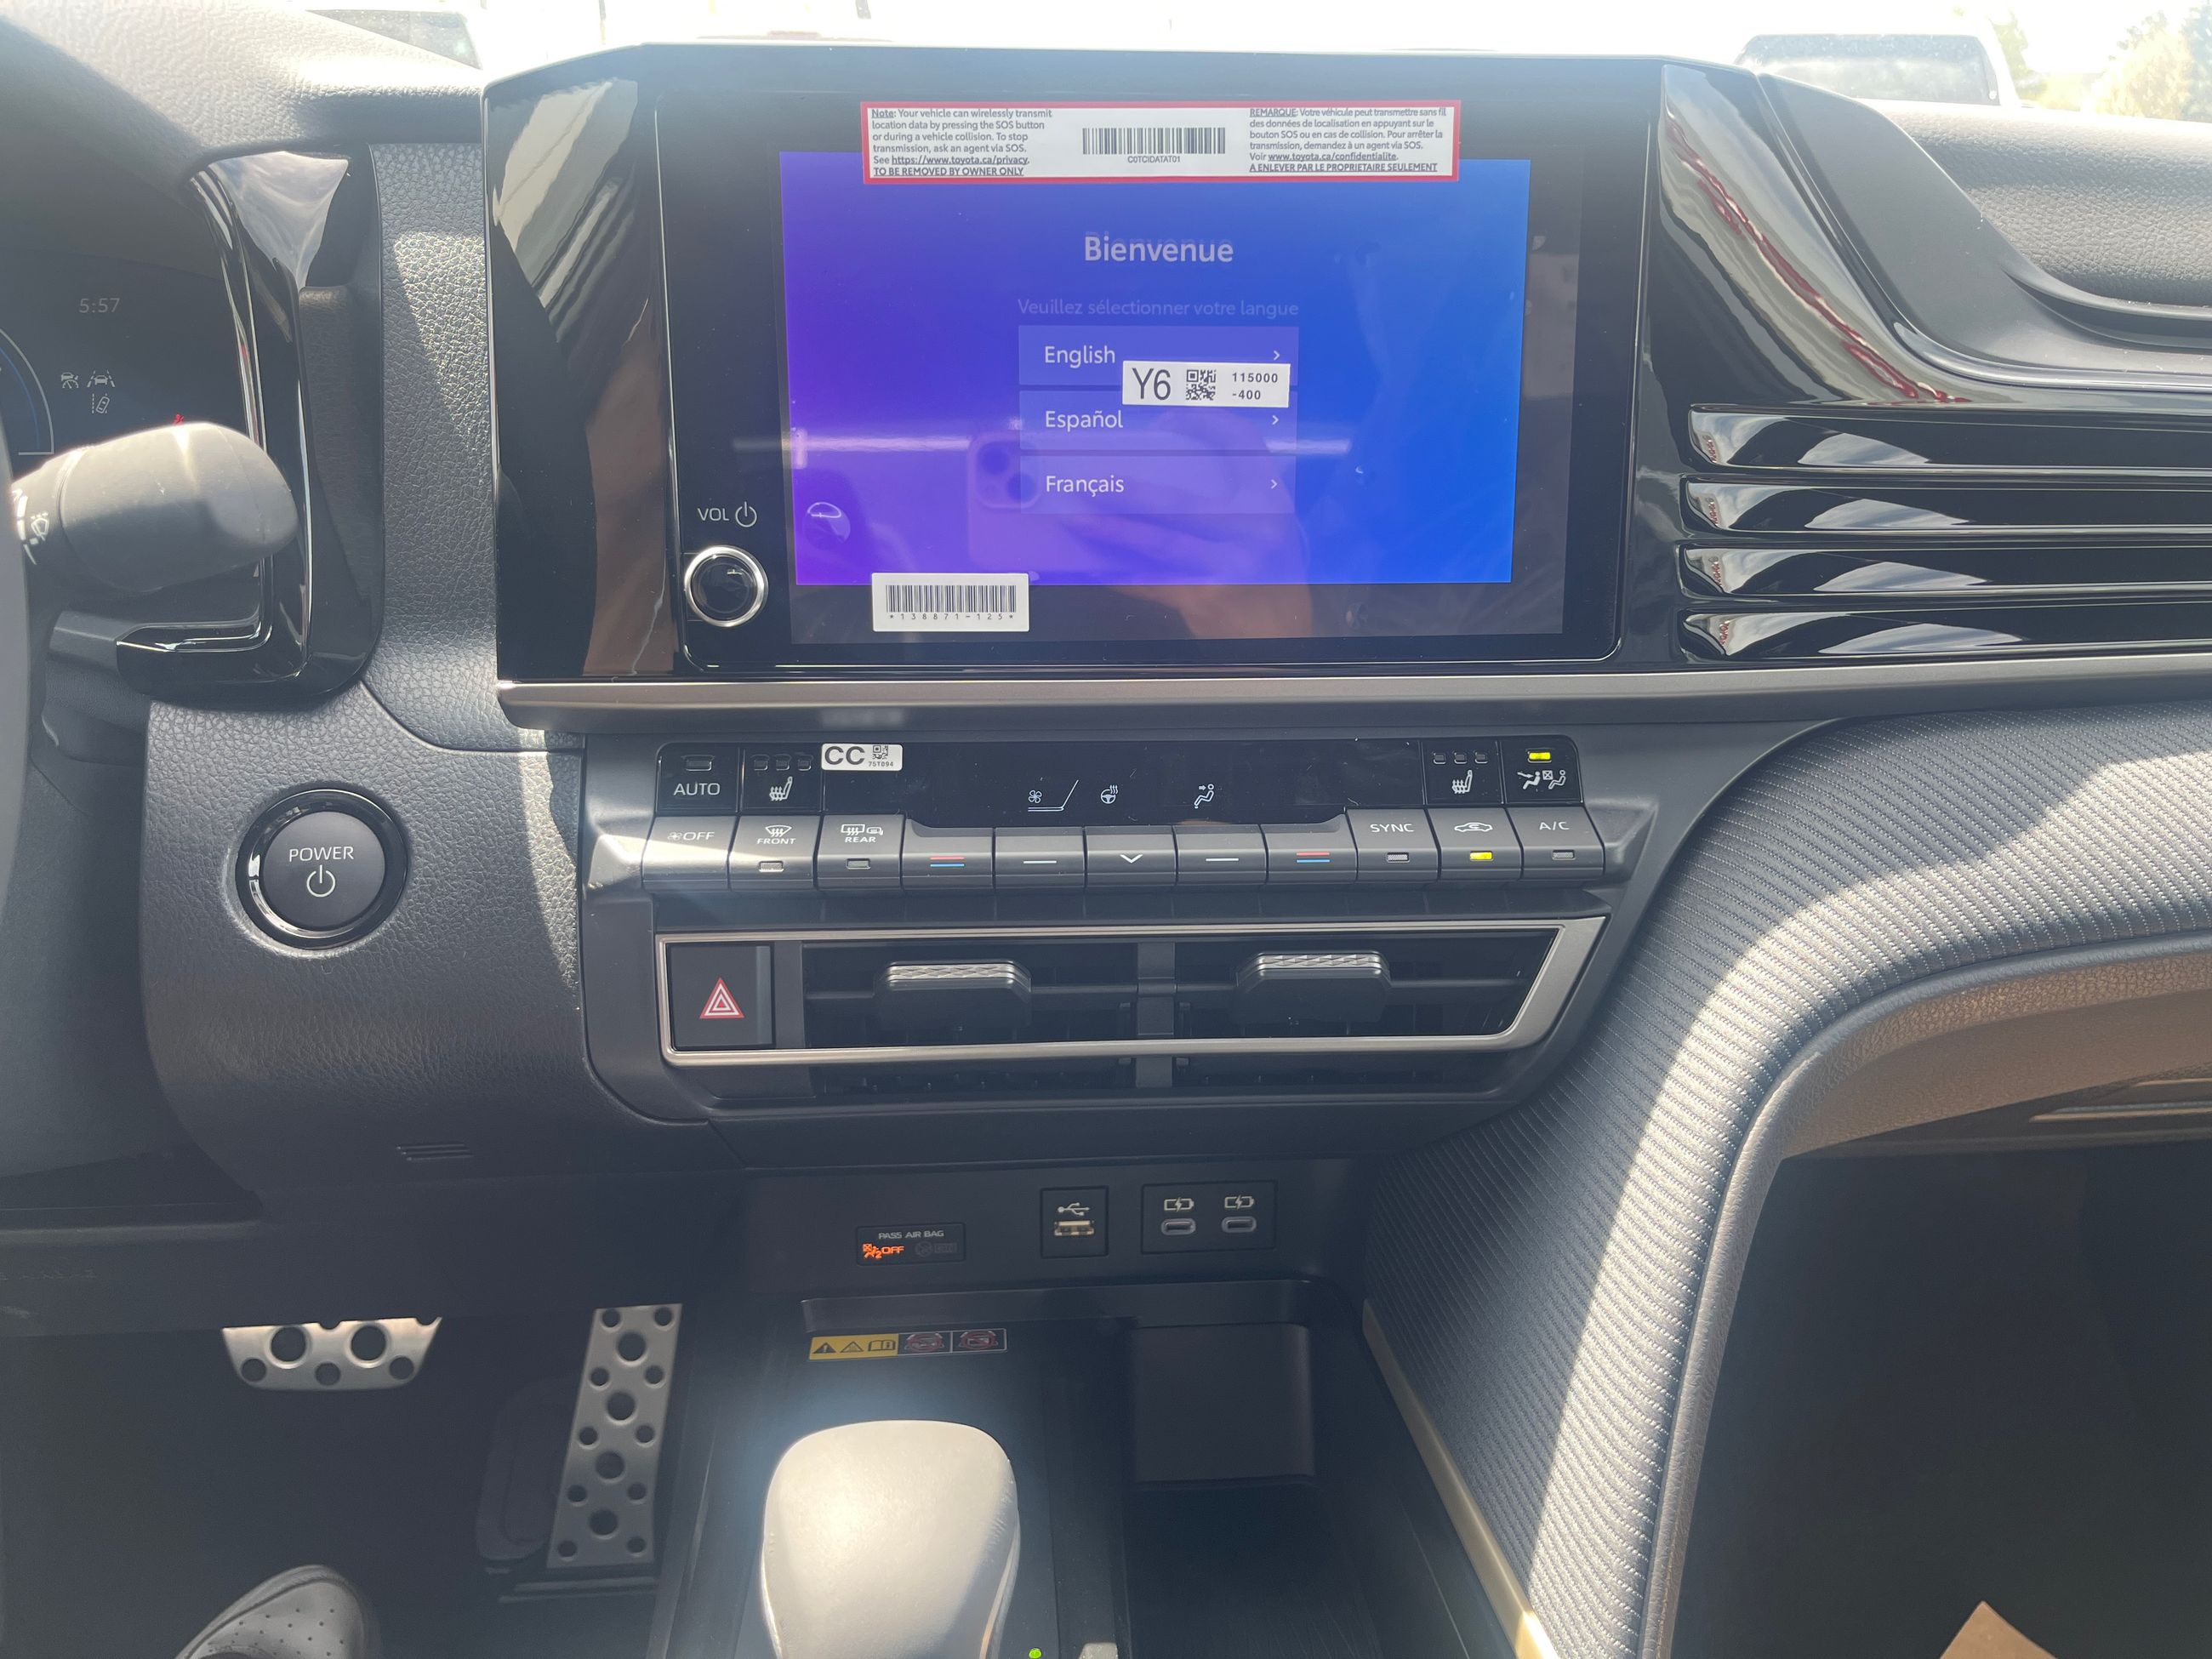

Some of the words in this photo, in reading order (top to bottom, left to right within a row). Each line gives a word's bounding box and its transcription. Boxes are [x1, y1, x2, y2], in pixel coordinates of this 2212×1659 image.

[871, 109, 896, 119] Note:
[898, 109, 918, 117] Your
[920, 109, 951, 117] vehicle
[971, 109, 1013, 119] wirelessly
[1016, 109, 1052, 117] transmit
[1250, 108, 1298, 117] REMARQUE:
[1299, 108, 1320, 117] Votre
[1321, 108, 1353, 117] véhicule
[1354, 109, 1372, 118] peut
[1374, 108, 1418, 117] transmettre
[872, 121, 906, 129] location
[909, 121, 927, 129] data
[930, 121, 940, 131] by
[942, 121, 978, 131] pressing
[980, 121, 994, 129] the
[995, 121, 1014, 129] SOS
[1016, 121, 1045, 129] button
[1250, 119, 1264, 128] des
[1266, 119, 1301, 128] données
[1302, 119, 1313, 128] de
[1314, 119, 1360, 128] localisation
[1373, 120, 1411, 129] appuyant
[1426, 119, 1434, 128] le
[884, 132, 913, 143] during
[922, 132, 953, 141] vehicle
[955, 132, 994, 141] collision.
[996, 133, 1006, 141] To
[1008, 133, 1029, 143] stop
[1338, 130, 1349, 139] de
[1350, 130, 1386, 139] collision.
[1387, 130, 1405, 139] Pour
[1407, 129, 1434, 139] arrêter
[1434, 129, 1443, 139] la
[873, 144, 932, 153] transmission,
[933, 144, 949, 152] ask
[964, 145, 989, 154] agent
[990, 144, 1003, 152] via
[1006, 144, 1027, 152] SOS.
[1250, 141, 1303, 151] transmission,
[1303, 141, 1346, 150] demandez
[1348, 141, 1353, 150] à
[1366, 142, 1389, 151] agent
[1391, 141, 1402, 150] via
[1404, 141, 1423, 150] SOS.
[892, 155, 1030, 165] https://www.toyota.ca/privacy.
[1268, 152, 1399, 162] www.toyota.ca/confidentialite.
[873, 167, 887, 177] TO
[888, 167, 900, 177] BE
[902, 167, 948, 177] REMOVED
[949, 167, 960, 177] BY
[962, 167, 997, 177] OWNER
[999, 167, 1024, 177] ONLY
[1249, 163, 1257, 173] A
[1257, 163, 1295, 173] ENLEVER
[1297, 163, 1314, 173] PAR
[1315, 163, 1324, 173] LE
[1327, 163, 1385, 172] PROPRIETAIRE
[1387, 163, 1438, 172] SEULEMENT
[1084, 236, 1234, 263] Bienvenue
[78, 298, 121, 314] 5:57
[1018, 298, 1083, 315] Veuillez
[1088, 299, 1190, 316] sélectionner
[1193, 302, 1234, 316] votre
[1240, 299, 1299, 319] langue
[1045, 345, 1116, 368] English
[1232, 373, 1278, 384] 115000
[1132, 368, 1172, 401] Y6
[1232, 390, 1262, 400] -400
[1045, 410, 1123, 432] Español
[1046, 475, 1125, 497] Français
[698, 508, 729, 522] VOL
[824, 745, 865, 766] CC
[674, 783, 721, 796] AUTO
[1370, 824, 1415, 833] SYNC
[1539, 821, 1570, 830] A/C
[683, 831, 715, 841] OFF
[289, 846, 354, 863] POWER
[881, 1246, 904, 1254] OFF
